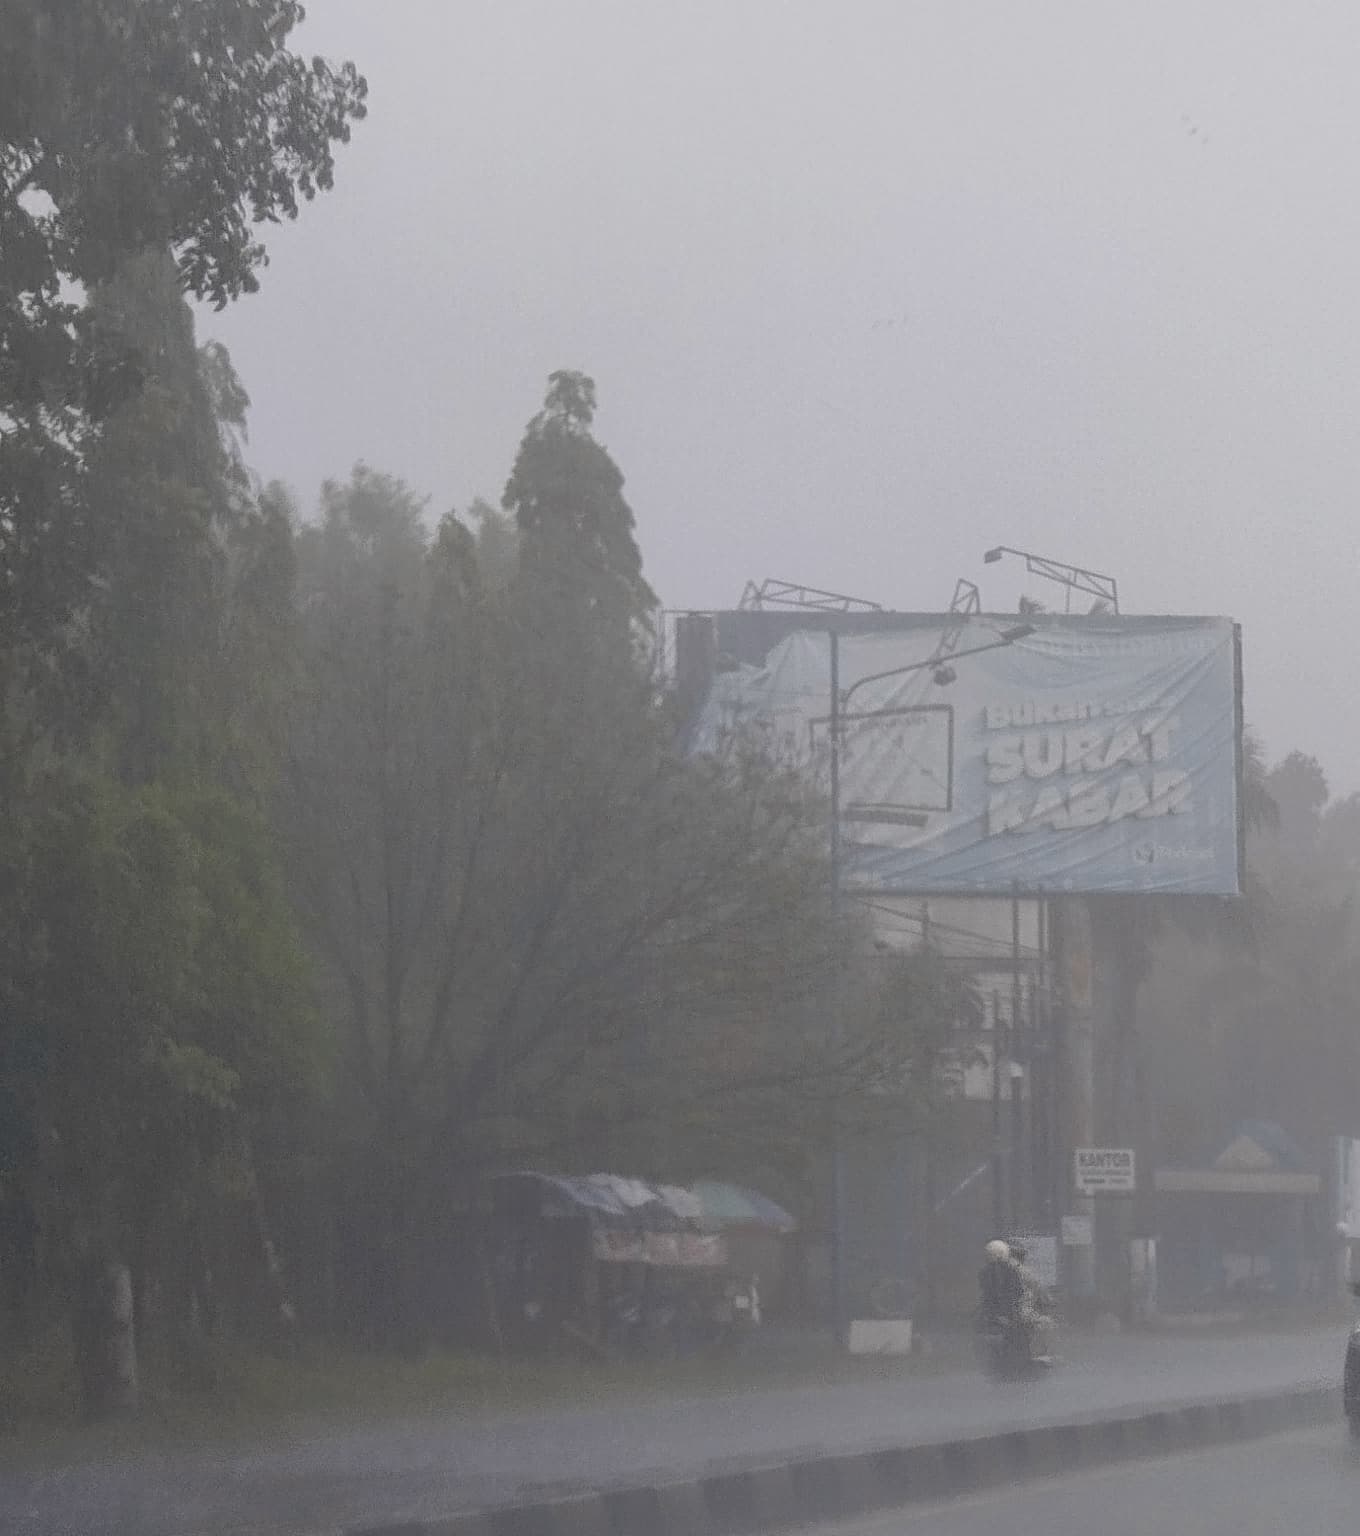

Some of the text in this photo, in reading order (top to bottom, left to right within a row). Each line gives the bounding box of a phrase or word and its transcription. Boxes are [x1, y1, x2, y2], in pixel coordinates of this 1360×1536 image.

[986, 716, 1179, 785] SURAT
[988, 769, 1194, 836] KABAR
[1079, 1152, 1131, 1167] KANTOR
